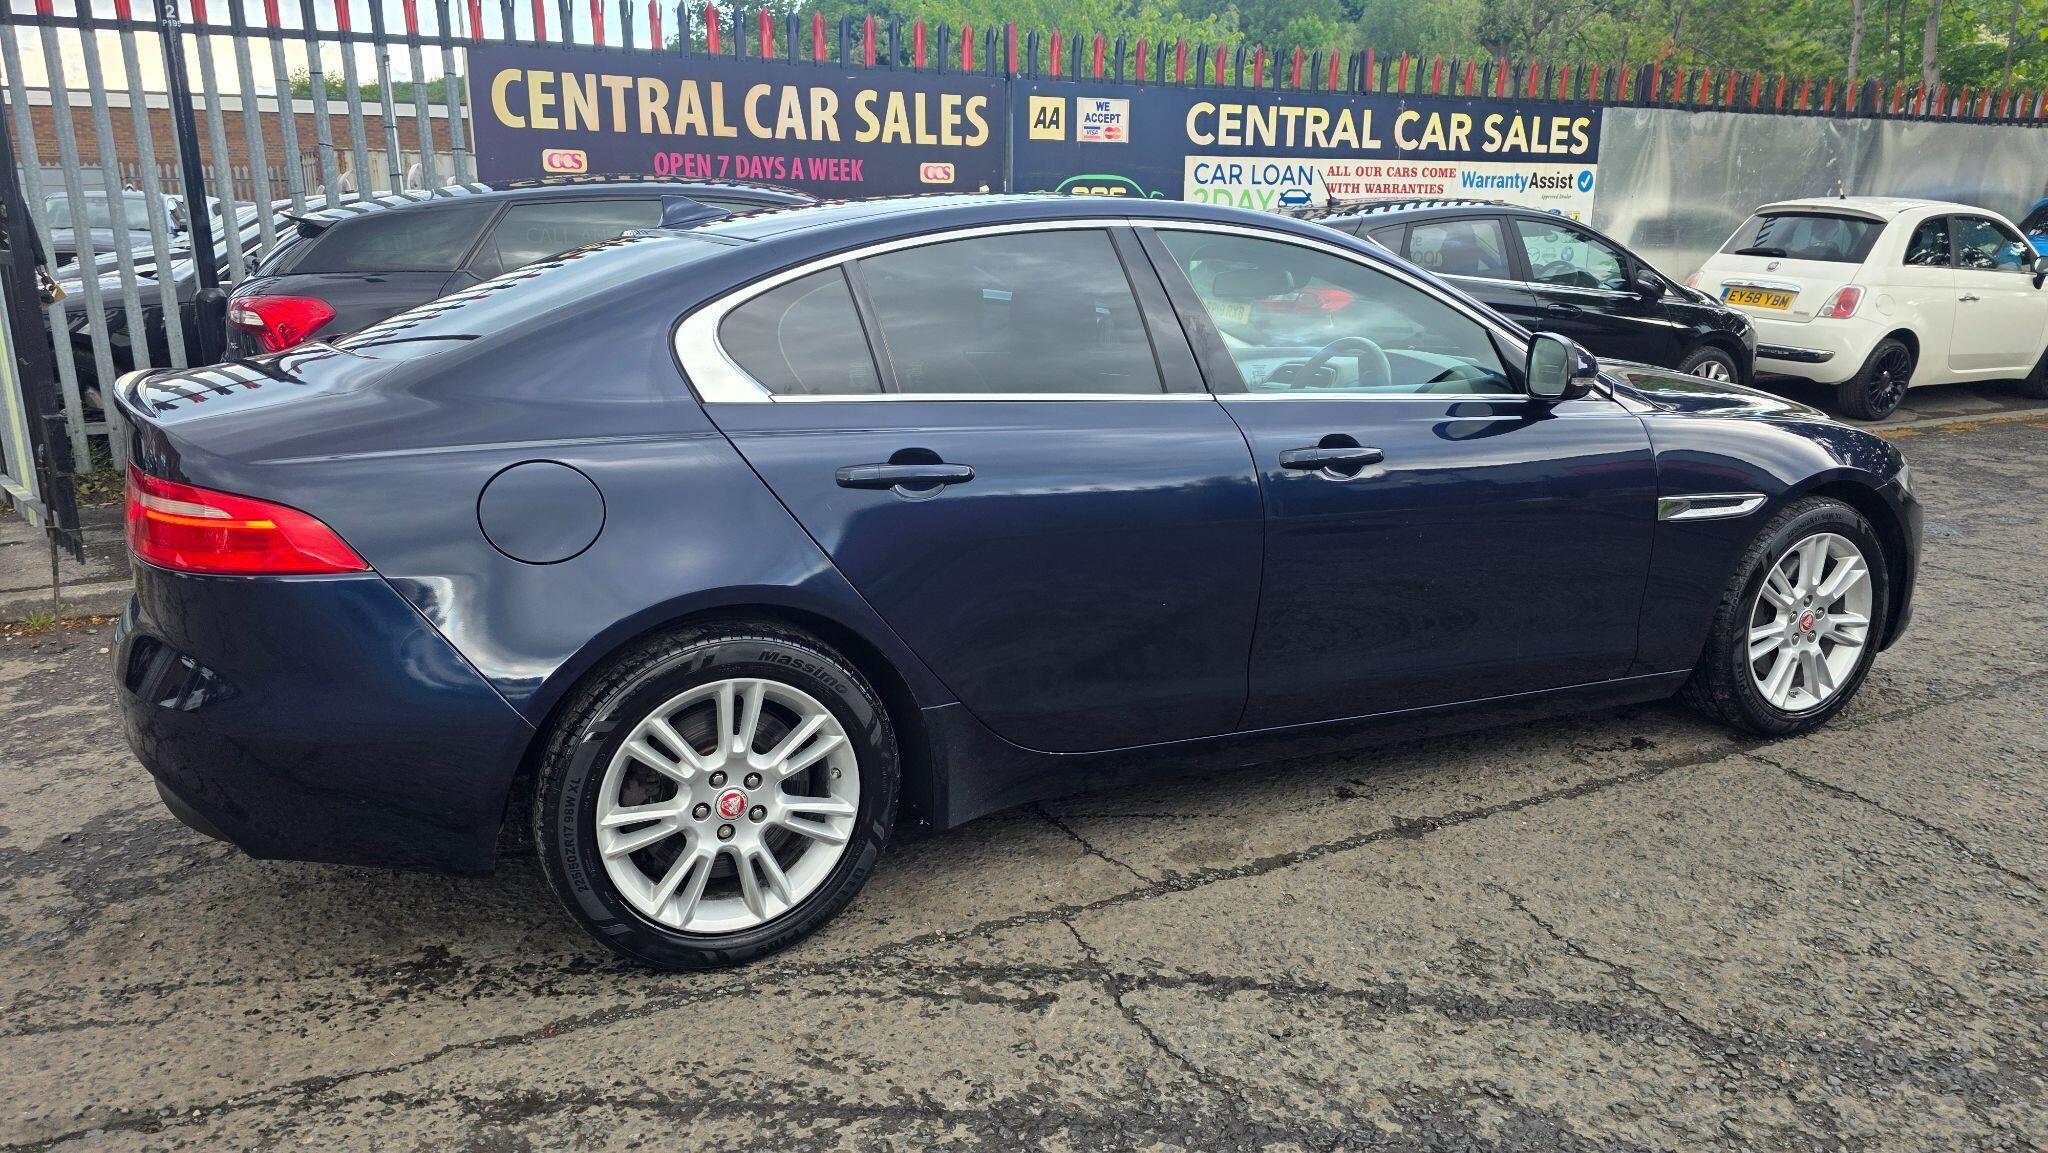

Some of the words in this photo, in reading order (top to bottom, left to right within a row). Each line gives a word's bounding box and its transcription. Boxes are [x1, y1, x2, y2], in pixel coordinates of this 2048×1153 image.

[165, 4, 176, 18] 2
[491, 68, 738, 138] CENTRAL
[743, 83, 841, 142] CAR
[854, 89, 989, 147] SALES
[1096, 101, 1110, 112] WE
[1033, 106, 1060, 129] AA
[1084, 112, 1121, 124] ACCEPT
[1186, 101, 1382, 149] CENTRAL
[1394, 110, 1473, 151] CAR
[1481, 113, 1591, 155] SALES
[653, 151, 712, 178] OPEN
[717, 155, 729, 178] 7
[735, 155, 786, 180] DAYS
[791, 156, 804, 180] A
[808, 157, 864, 182] WEEK
[1193, 163, 1243, 185] CAR
[1251, 164, 1314, 186] LOAN
[1327, 165, 1351, 177] ALL
[1355, 166, 1382, 178] OUR
[1386, 167, 1418, 179] CARS
[1421, 167, 1457, 179] COME
[1327, 182, 1360, 194] WITH
[1365, 183, 1444, 195] WARRANTIES
[1728, 290, 1764, 303] EY58
[1764, 294, 1791, 307] YBM
[757, 650, 849, 694] Massimo
[568, 777, 582, 794] XL
